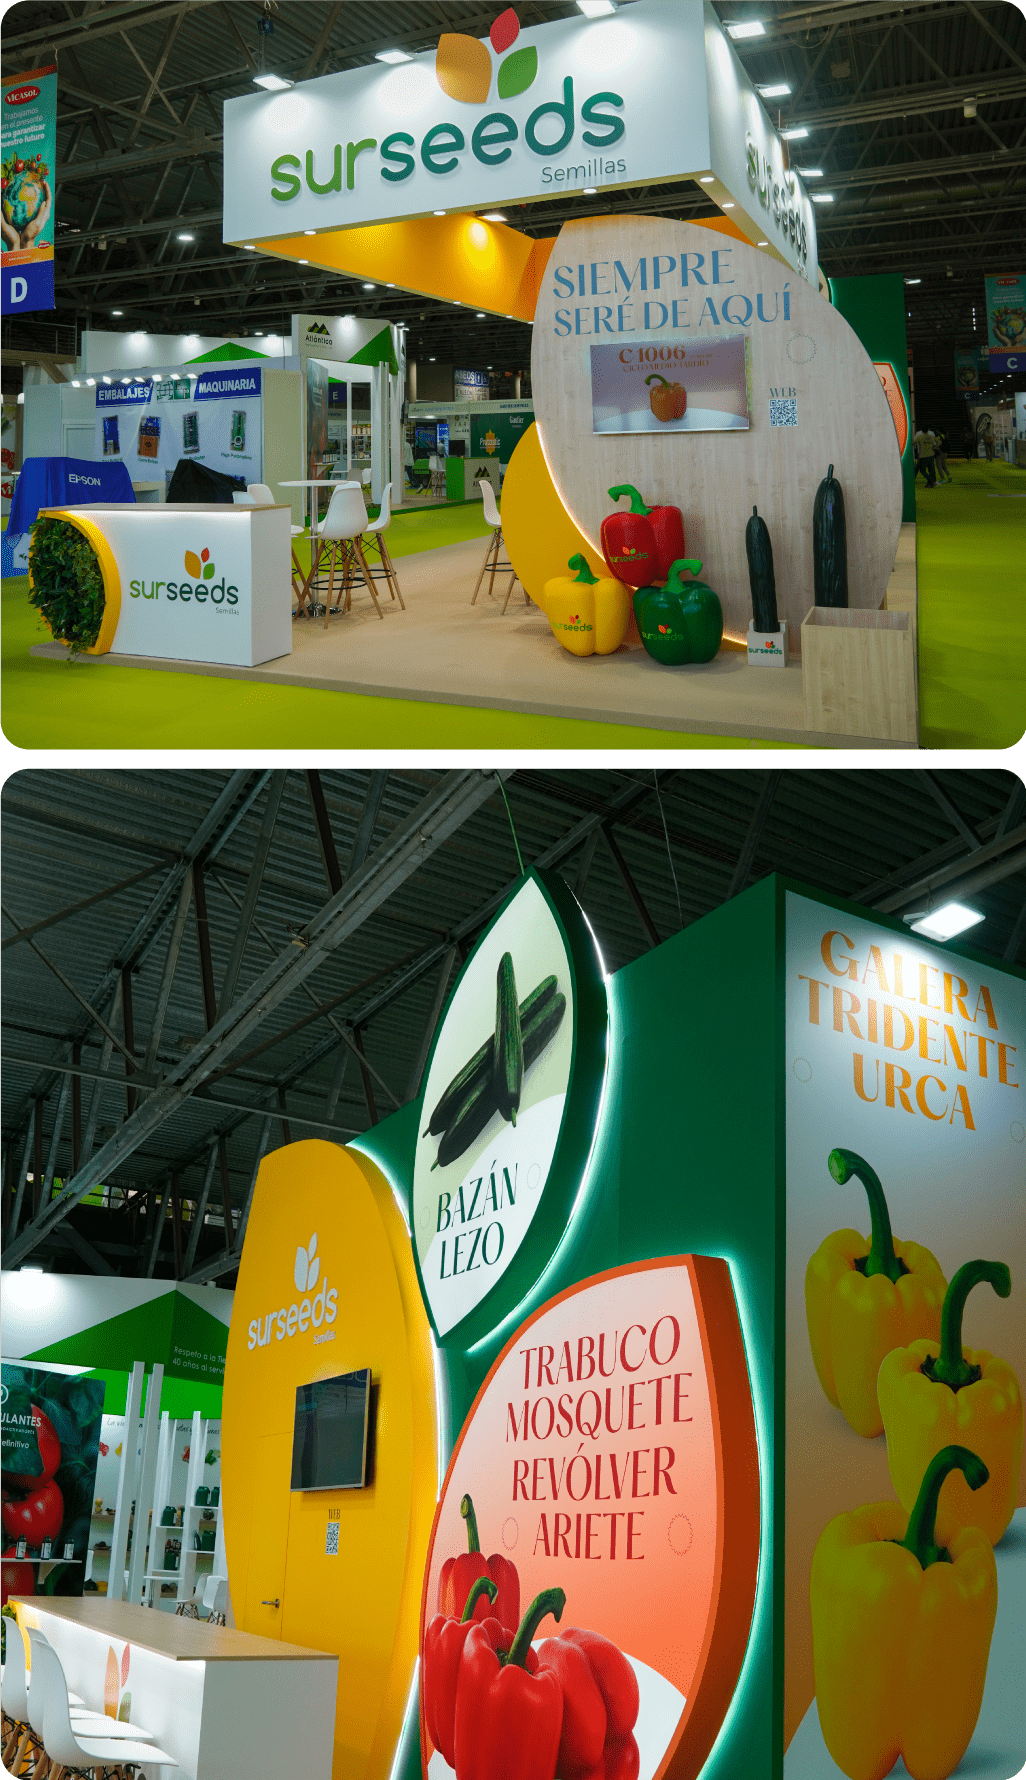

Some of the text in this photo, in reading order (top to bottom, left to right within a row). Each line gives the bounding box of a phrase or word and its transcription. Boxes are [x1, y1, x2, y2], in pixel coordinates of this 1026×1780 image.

[7, 89, 38, 102] VICASOL
[4, 107, 39, 120] Trabajamos
[1, 115, 43, 131] en el presente
[12, 124, 46, 138] garantizar
[24, 133, 45, 143] futuro
[271, 76, 625, 202] surseeds
[542, 155, 626, 184] Semillas
[553, 248, 735, 299] SIEMPRE
[11, 276, 28, 304] D
[553, 283, 790, 338] SERÉ DE AQUÍ
[305, 335, 333, 346] Atlántico
[619, 345, 686, 364] C 1006
[1007, 357, 1018, 369] C
[649, 361, 677, 371] MEDIO
[679, 359, 710, 369] TARDÍO
[98, 386, 150, 401] EMBALAJES
[198, 378, 256, 394] MAQUINARIA
[333, 391, 339, 400] E
[769, 387, 797, 397] WEB
[69, 473, 101, 486] EPSON
[609, 551, 649, 563] surseeds
[129, 577, 239, 605] surseeds
[215, 607, 240, 615] Semillas
[552, 621, 593, 632] surseeds
[641, 631, 684, 641] surseeds
[748, 646, 783, 655] surseeds
[820, 930, 999, 1031] GALERA
[798, 974, 1020, 1089] TRIDENTE
[853, 1051, 977, 1132] URCA
[437, 1160, 518, 1233] BAZÁN
[439, 1220, 505, 1280] LEZO
[248, 1276, 339, 1351] surseeds
[174, 1345, 201, 1359] Respeto
[210, 1353, 216, 1362] la
[519, 1314, 681, 1391] TRABUCO
[172, 1357, 181, 1366] 40
[182, 1359, 199, 1370] años
[201, 1363, 208, 1371] al
[506, 1372, 694, 1443] MOSQUETE
[512, 1443, 678, 1502] REVÓLVER
[532, 1511, 645, 1561] ARIETE
